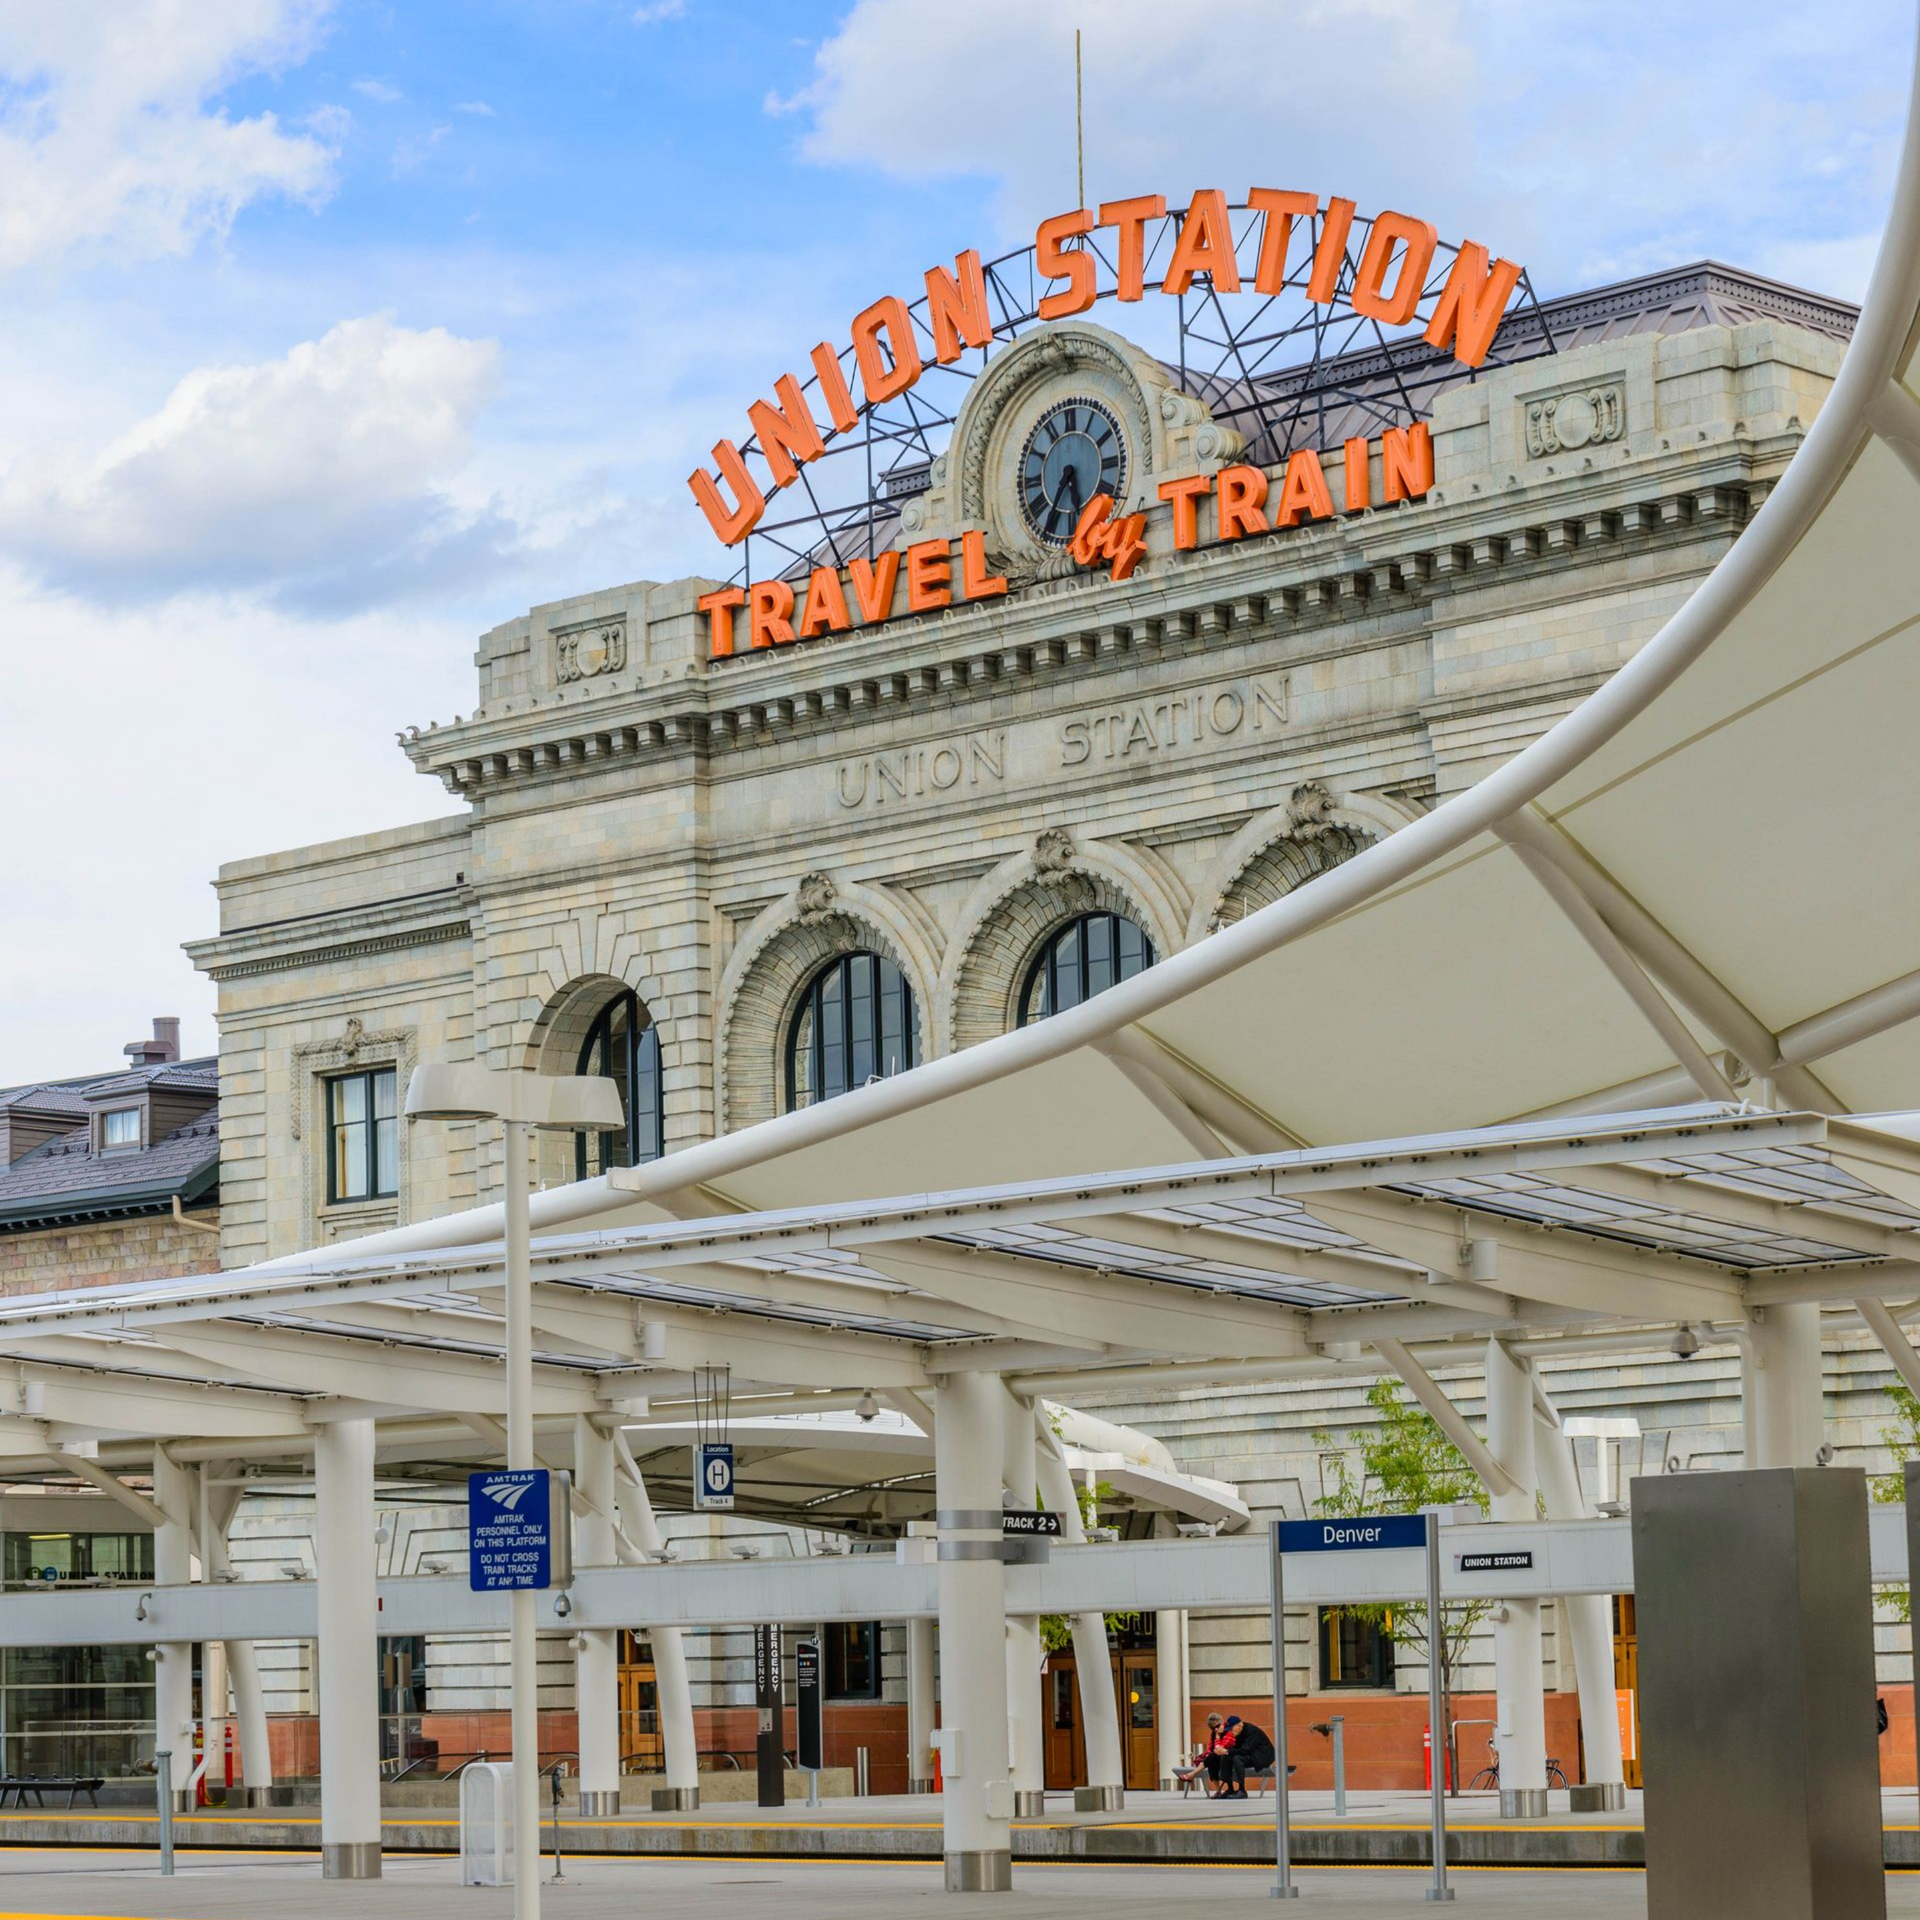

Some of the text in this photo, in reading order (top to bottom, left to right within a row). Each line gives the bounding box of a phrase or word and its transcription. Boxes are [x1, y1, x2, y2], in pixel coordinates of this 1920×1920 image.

[687, 187, 1522, 545] UNION STATION
[698, 421, 1435, 658] TRAVEL by TRAIN
[835, 676, 1290, 808] UNION STATION
[486, 1474, 535, 1484] AMTRAK
[712, 1465, 724, 1485] H
[493, 1514, 525, 1524] AMTRAK
[1003, 1516, 1047, 1531] TRACK 2
[476, 1525, 543, 1536] PERSONNEL ONLY
[1323, 1526, 1382, 1544] Denver
[473, 1536, 546, 1548] ON THIS PLATFORM
[480, 1552, 539, 1564] DO NOT CROSS
[1465, 1556, 1528, 1567] UNION STATION
[483, 1564, 538, 1575] TRAIN TRACKS
[487, 1576, 534, 1586] AT ANY TIME
[757, 1624, 765, 1693] MERGENCY
[770, 1623, 779, 1693] MERGENCY
